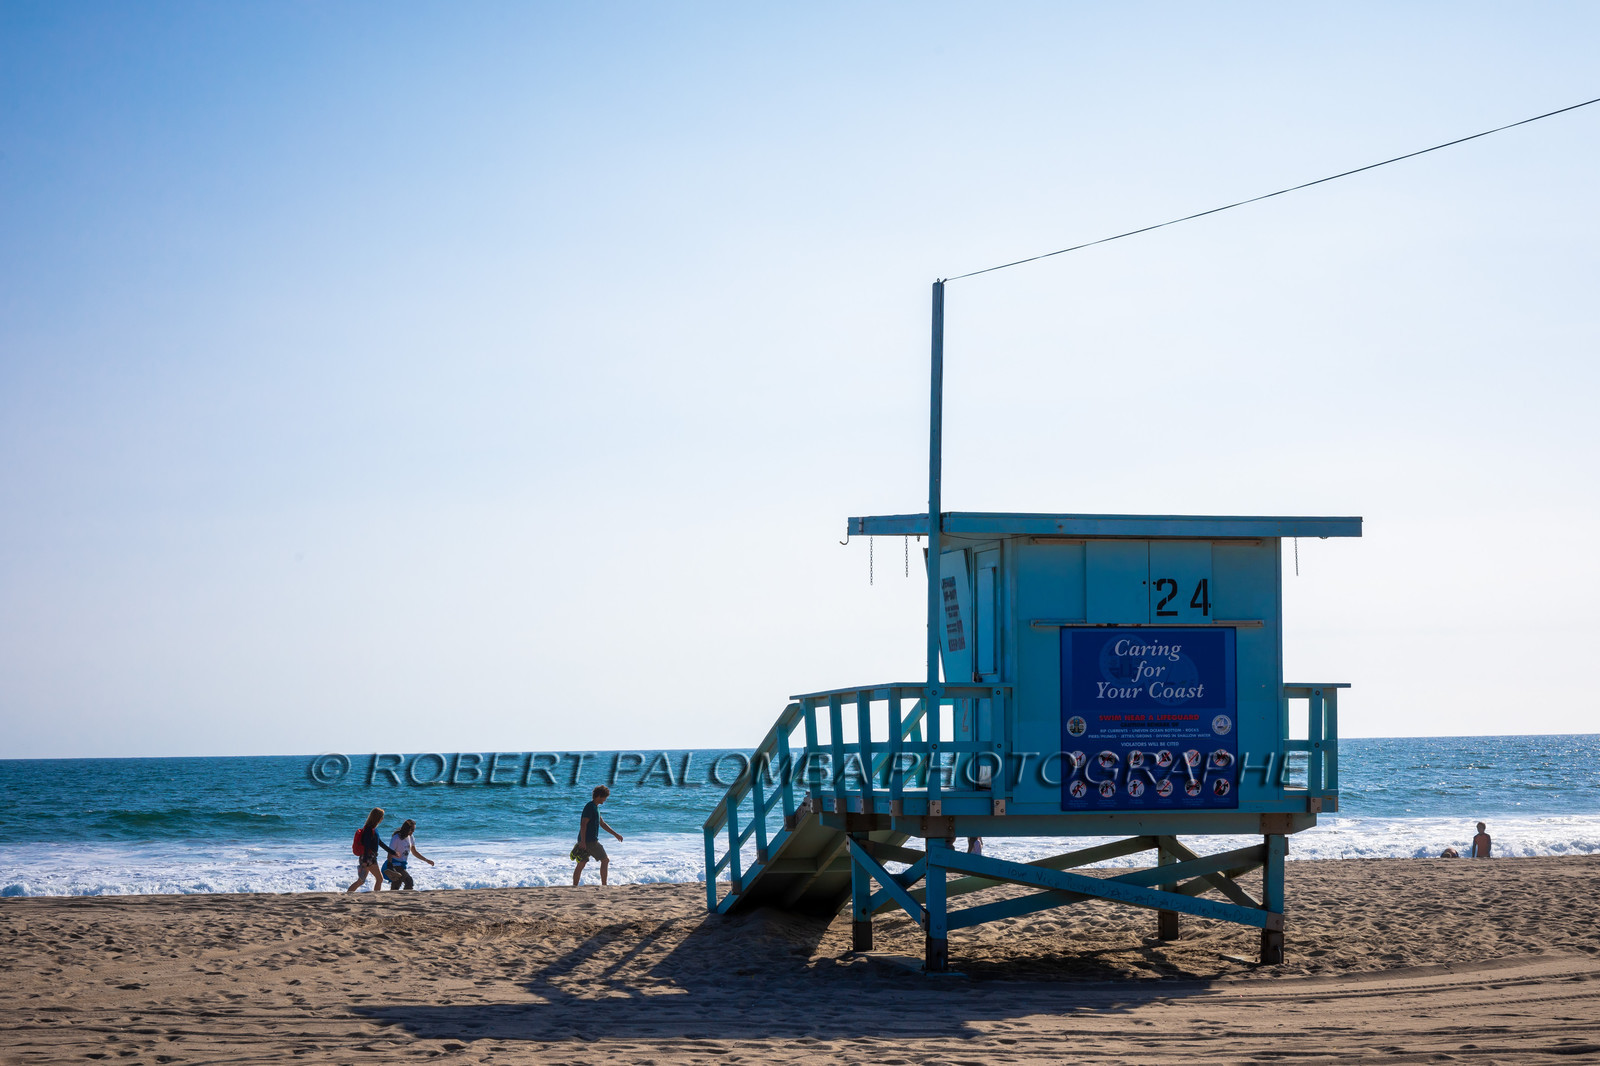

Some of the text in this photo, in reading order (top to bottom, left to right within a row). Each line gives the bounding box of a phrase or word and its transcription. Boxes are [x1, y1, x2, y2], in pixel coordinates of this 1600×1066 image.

[1156, 578, 1212, 617] 24
[1114, 639, 1182, 662] Caring
[1131, 660, 1166, 683] for
[1096, 681, 1205, 699] Your Coast
[1156, 713, 1200, 721] LIFEGUARD
